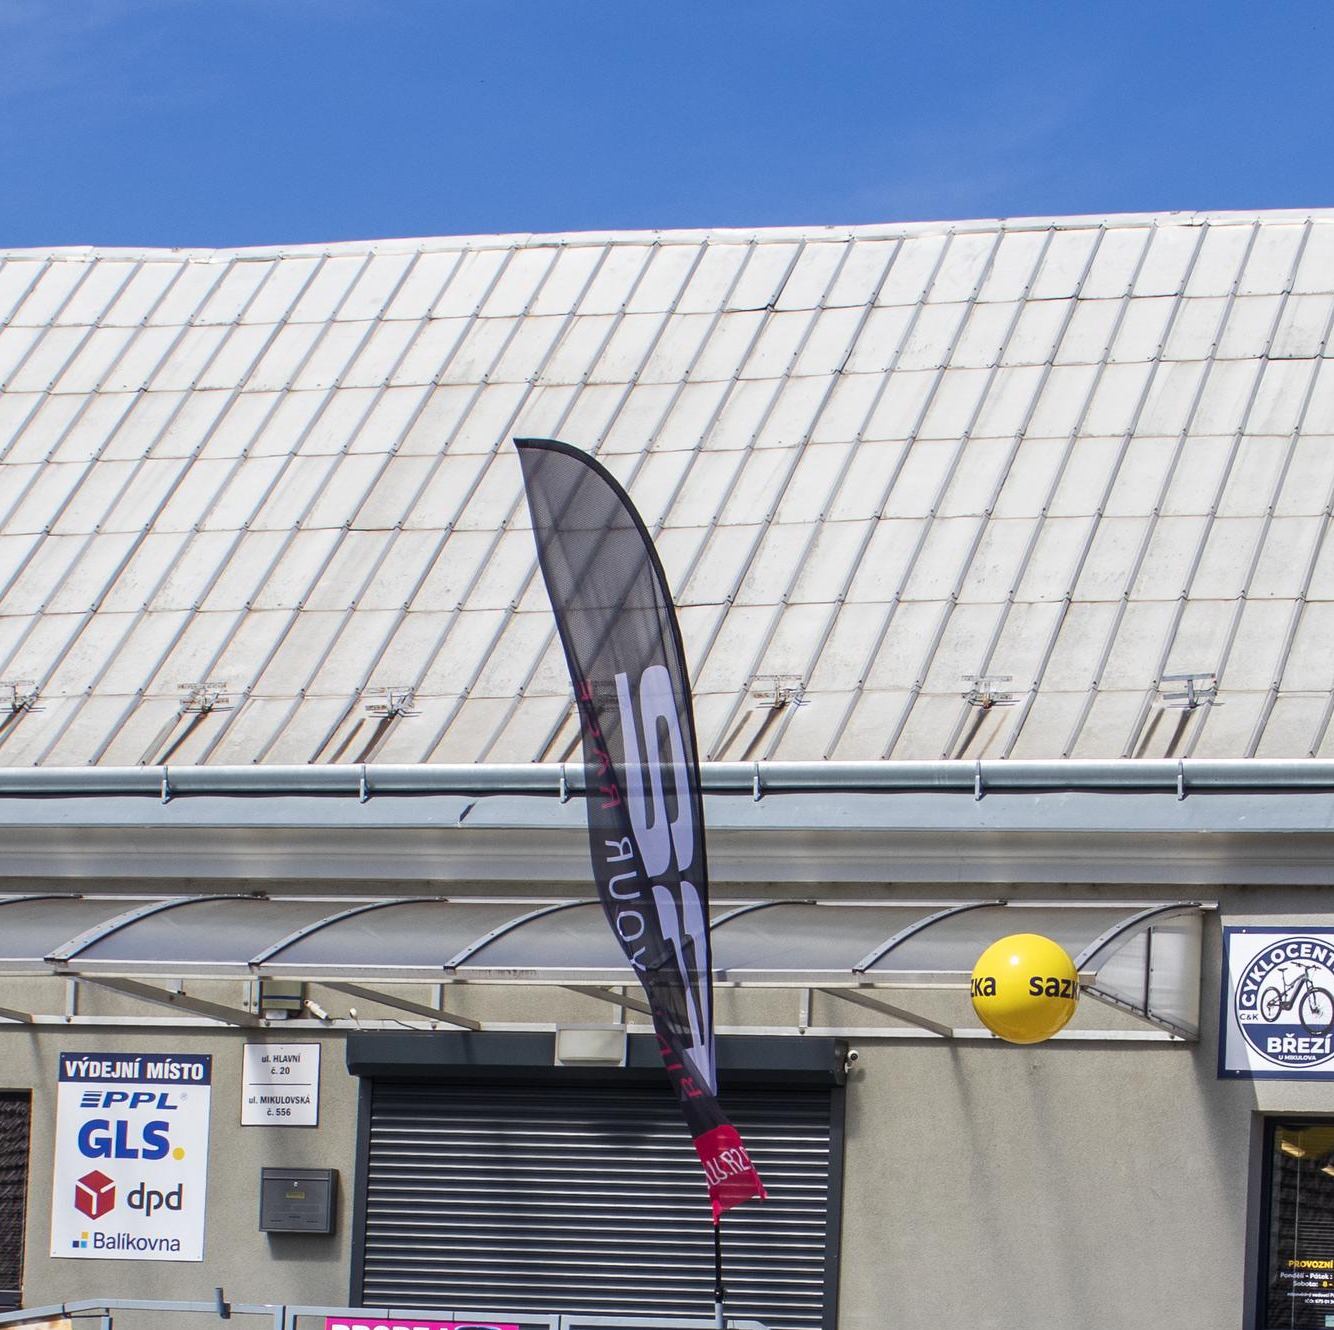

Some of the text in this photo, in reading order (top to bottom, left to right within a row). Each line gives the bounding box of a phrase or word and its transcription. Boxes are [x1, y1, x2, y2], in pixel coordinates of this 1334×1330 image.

[1267, 1033, 1333, 1054] BŘEZÍ
[273, 1052, 301, 1063] HLAVNÍ
[65, 1056, 204, 1081] VÝDEJNÍ MÍSTO
[280, 1067, 290, 1075] 20
[260, 1094, 310, 1104] MIKULOVSKÁ
[276, 1108, 291, 1116] 556
[127, 1182, 183, 1216] dpd
[93, 1232, 180, 1252] Balíkovna
[1288, 1260, 1333, 1269] PROVOZNÍ
